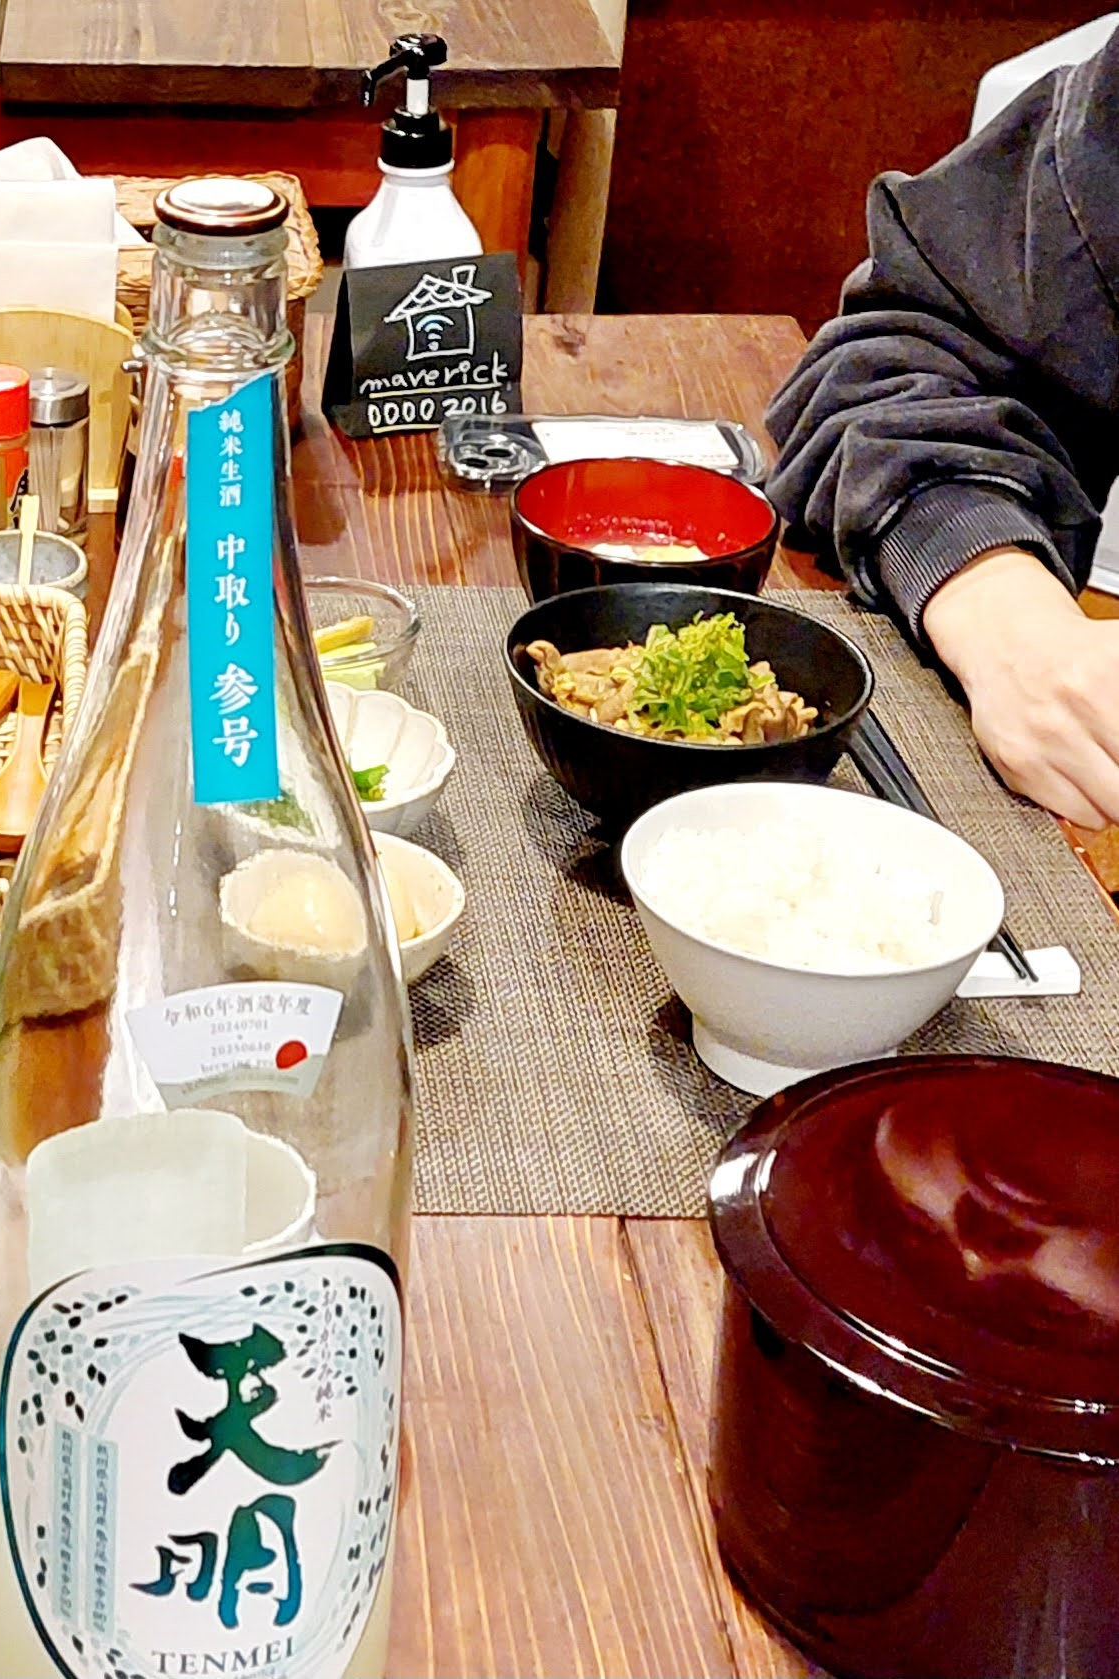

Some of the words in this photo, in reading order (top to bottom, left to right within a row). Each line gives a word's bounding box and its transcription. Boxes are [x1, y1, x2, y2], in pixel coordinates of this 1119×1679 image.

[359, 350, 509, 395] maverick
[218, 409, 245, 507] 純米生酒
[214, 533, 251, 648] 中取り
[209, 662, 260, 768] 参号
[165, 993, 312, 1028] 令和6年酒造年度
[129, 1322, 343, 1630] 天明
[151, 1636, 294, 1676] TENMEI
